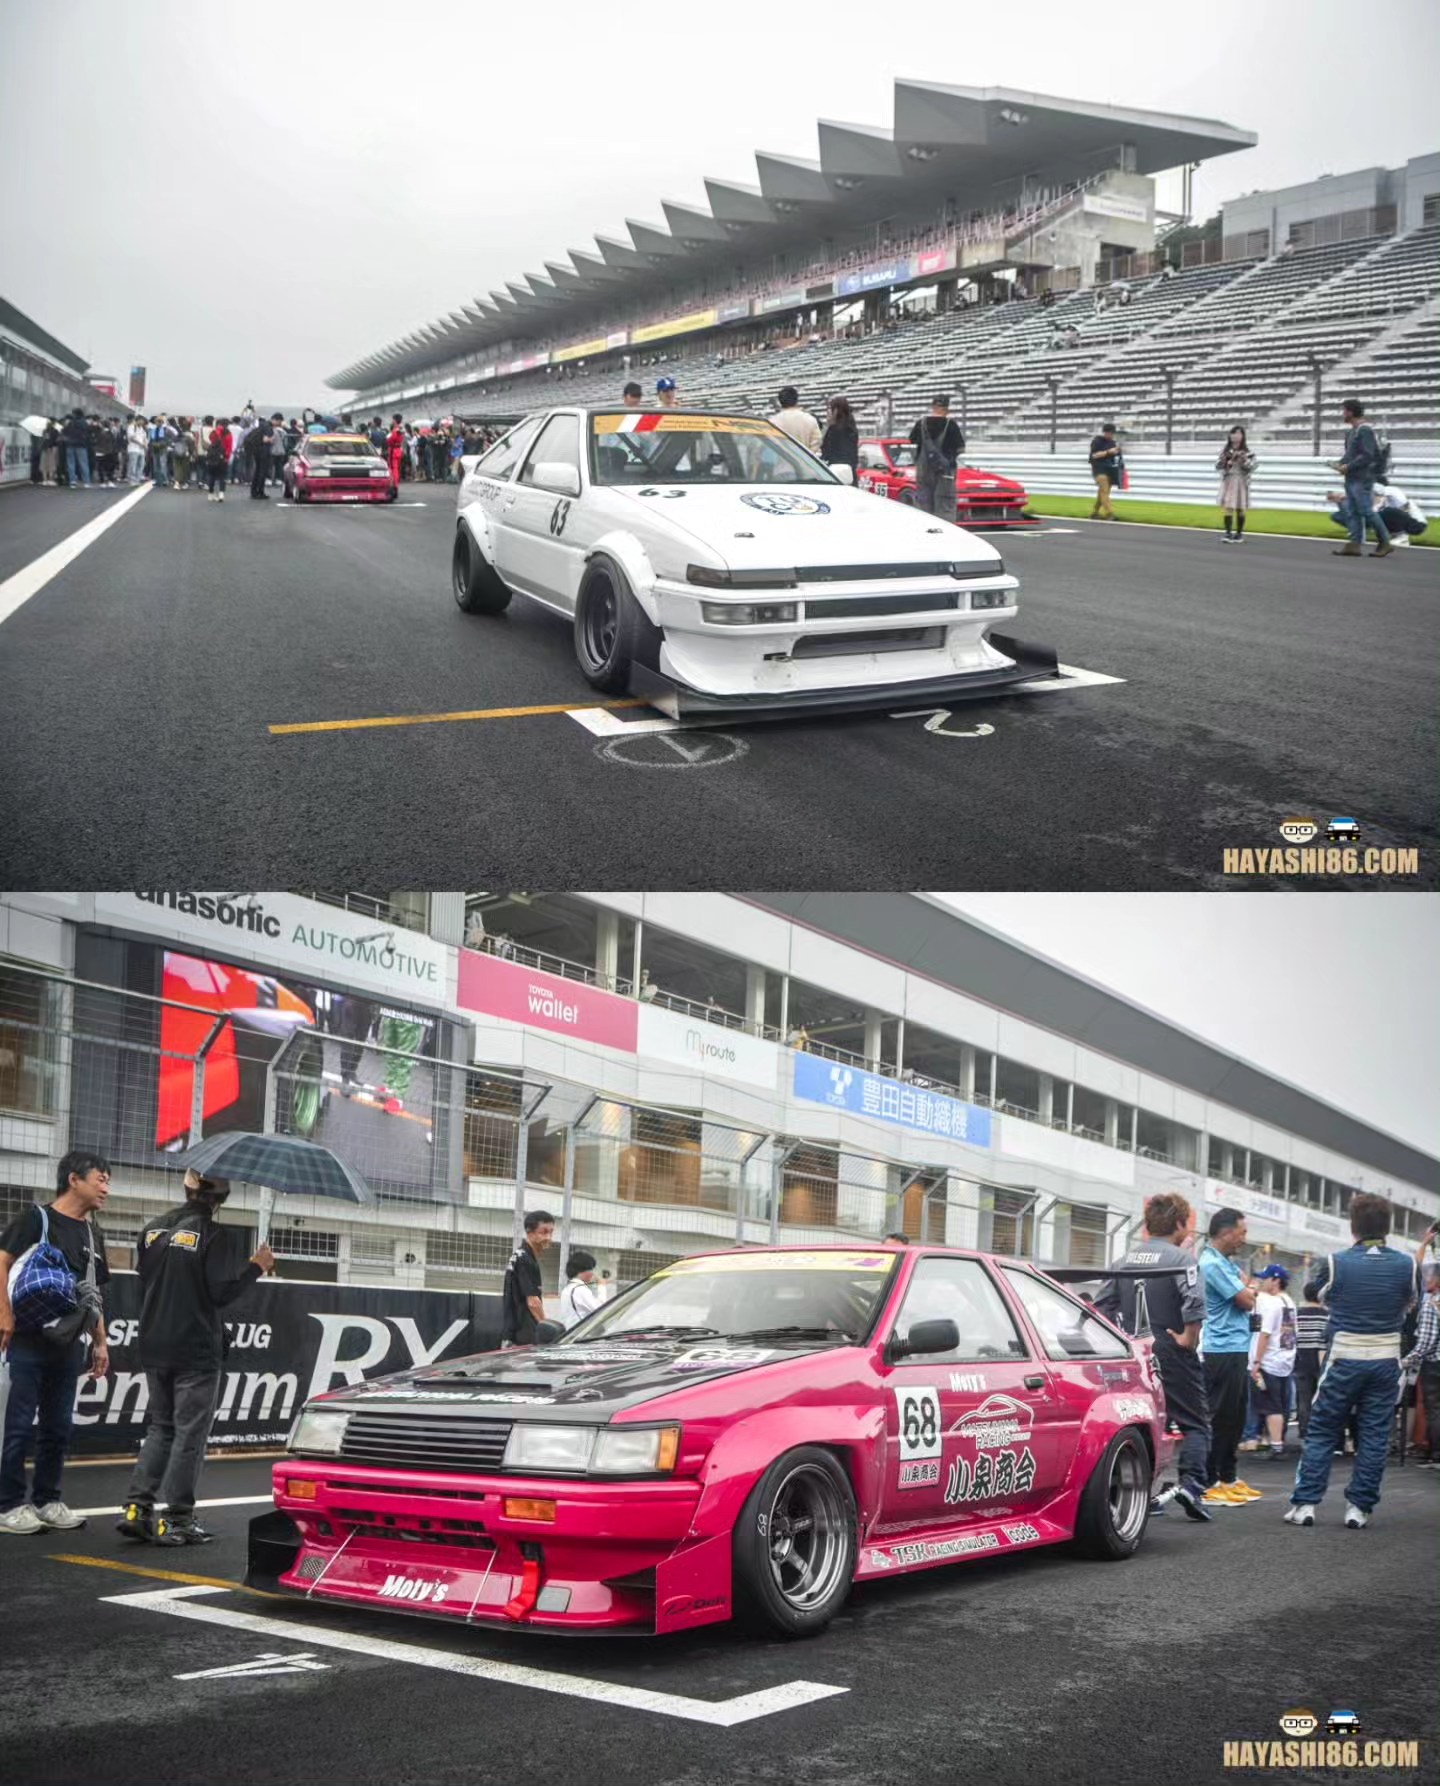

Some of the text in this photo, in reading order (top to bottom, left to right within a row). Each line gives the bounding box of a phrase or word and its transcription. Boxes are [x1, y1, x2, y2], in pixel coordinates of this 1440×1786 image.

[637, 488, 688, 499] 63
[550, 499, 570, 536] 63
[135, 892, 438, 983] anasonic AUTOMOTIVE
[528, 984, 554, 999] TOYOTA
[528, 995, 578, 1025] wallet
[862, 1078, 968, 1139] 豊田自動織機
[903, 1396, 937, 1449] 68
[892, 1545, 928, 1564] TSK
[377, 1574, 449, 1602] Moty's
